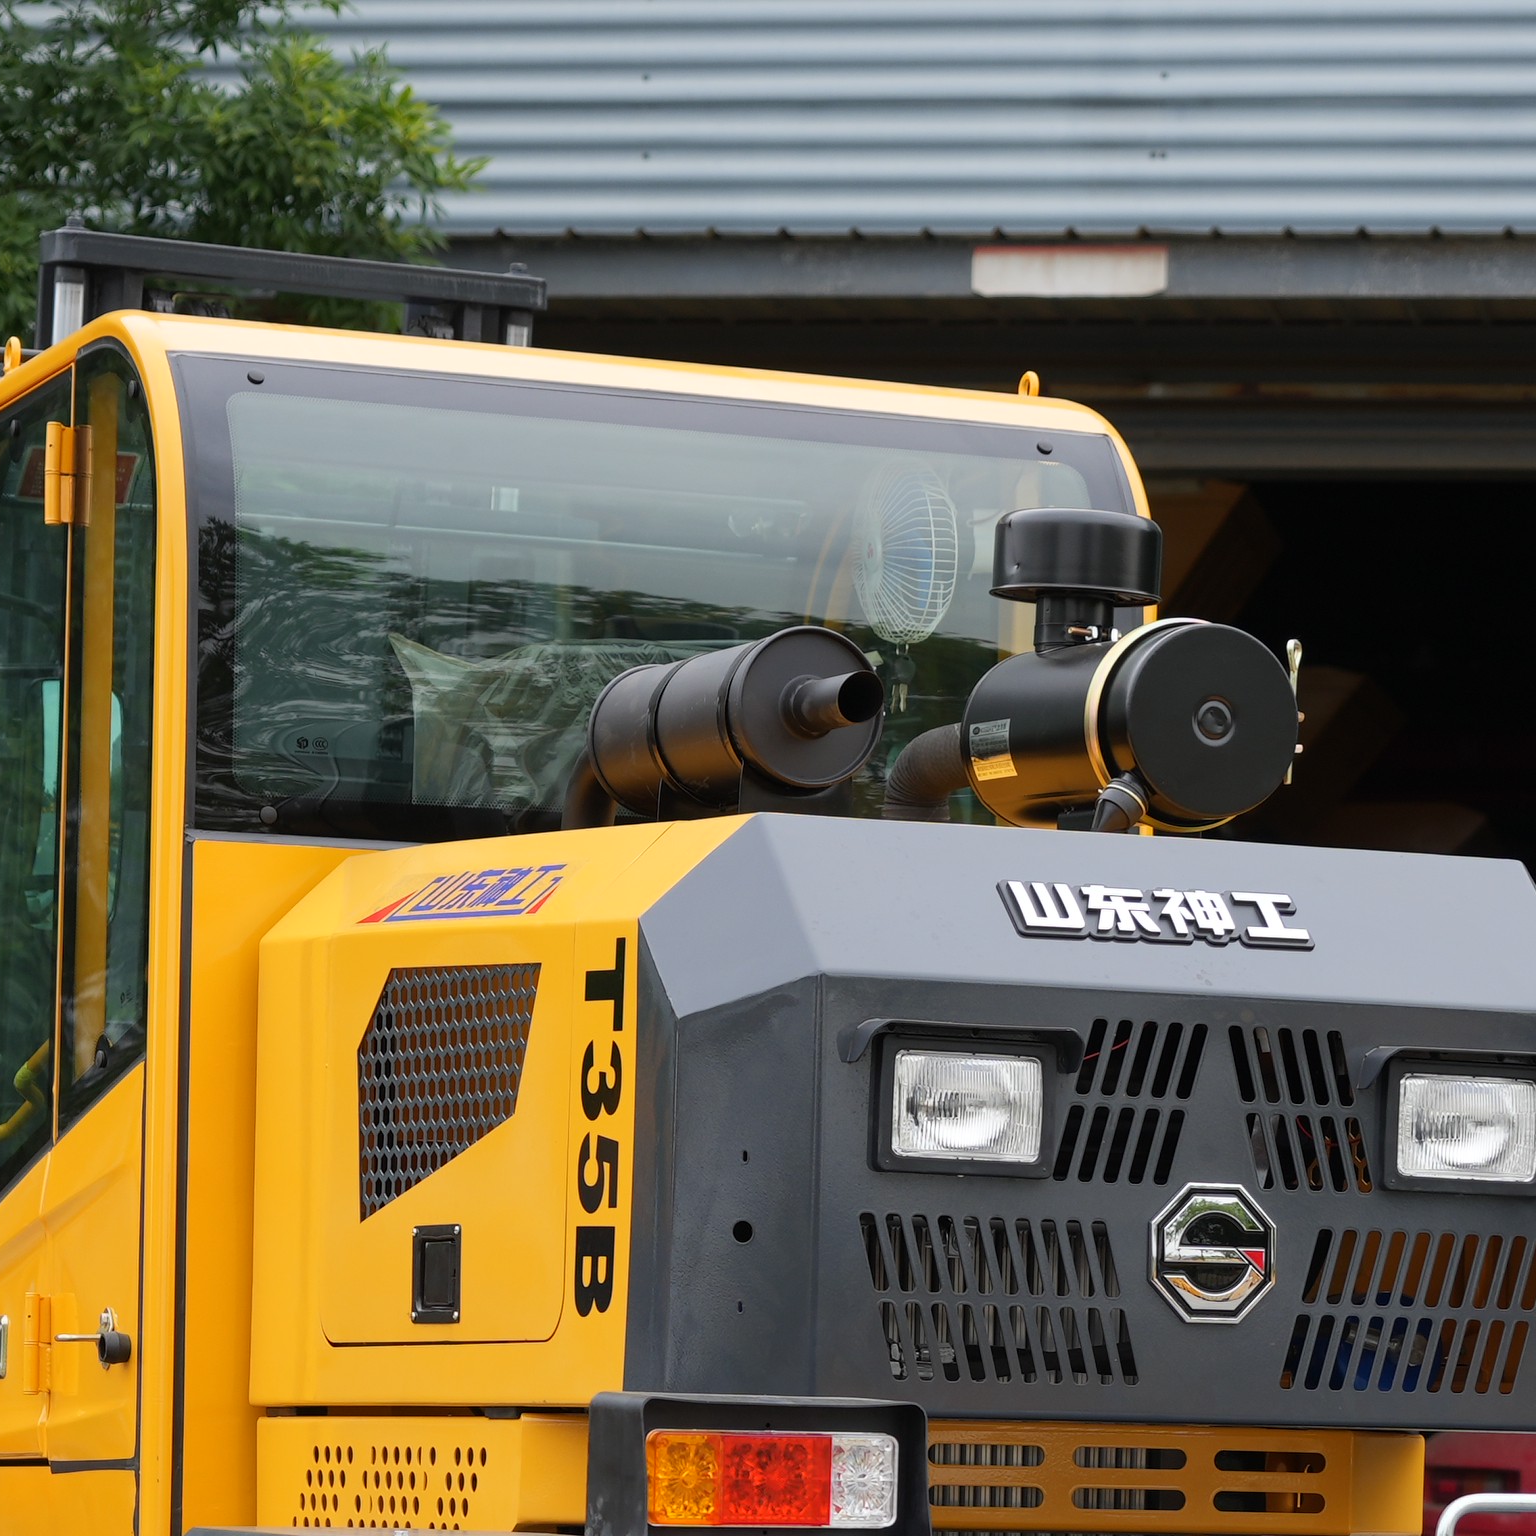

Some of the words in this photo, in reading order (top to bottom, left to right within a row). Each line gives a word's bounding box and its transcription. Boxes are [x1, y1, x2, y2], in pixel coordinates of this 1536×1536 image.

[408, 864, 568, 912] 山东神工
[1005, 879, 1310, 944] 山东神工
[574, 937, 626, 1318] T35B
